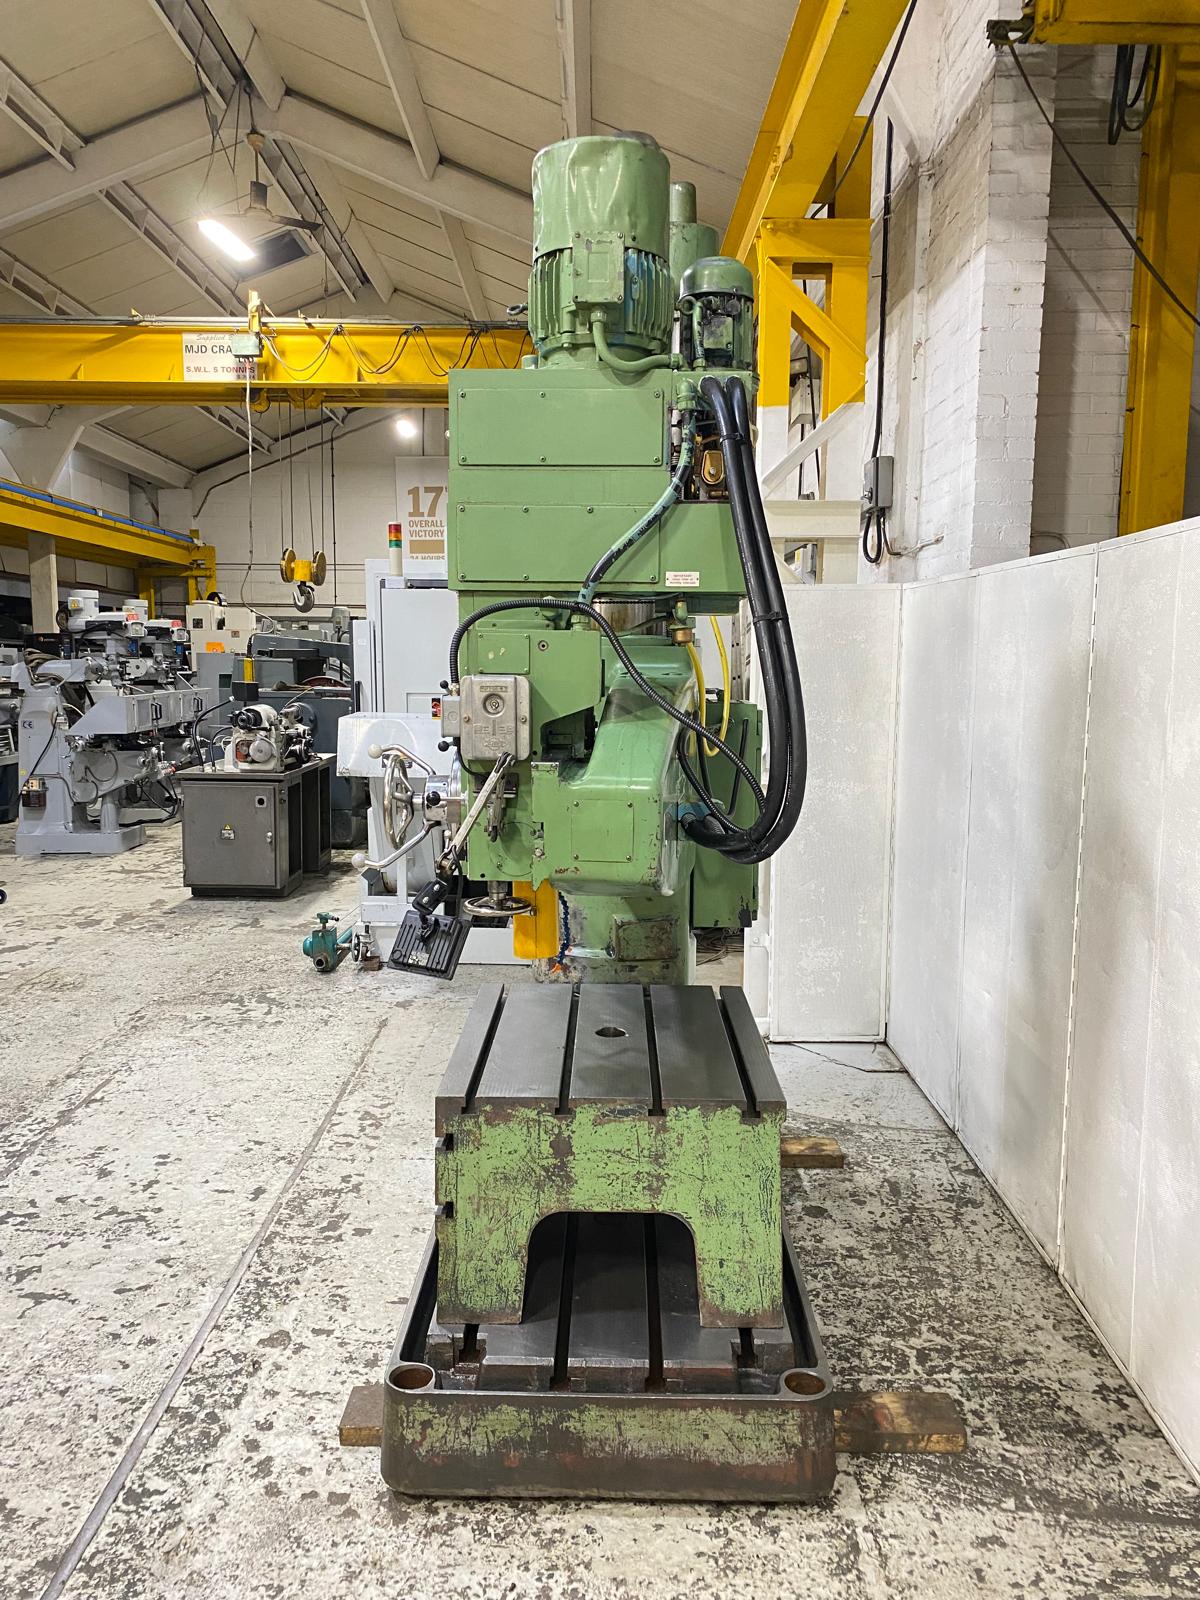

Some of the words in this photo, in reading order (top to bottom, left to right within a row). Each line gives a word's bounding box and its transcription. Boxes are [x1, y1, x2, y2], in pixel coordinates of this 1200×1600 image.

[185, 345, 207, 354] MJD
[211, 345, 233, 354] CRA
[409, 520, 445, 528] OVERALL
[409, 529, 445, 538] VICTORY
